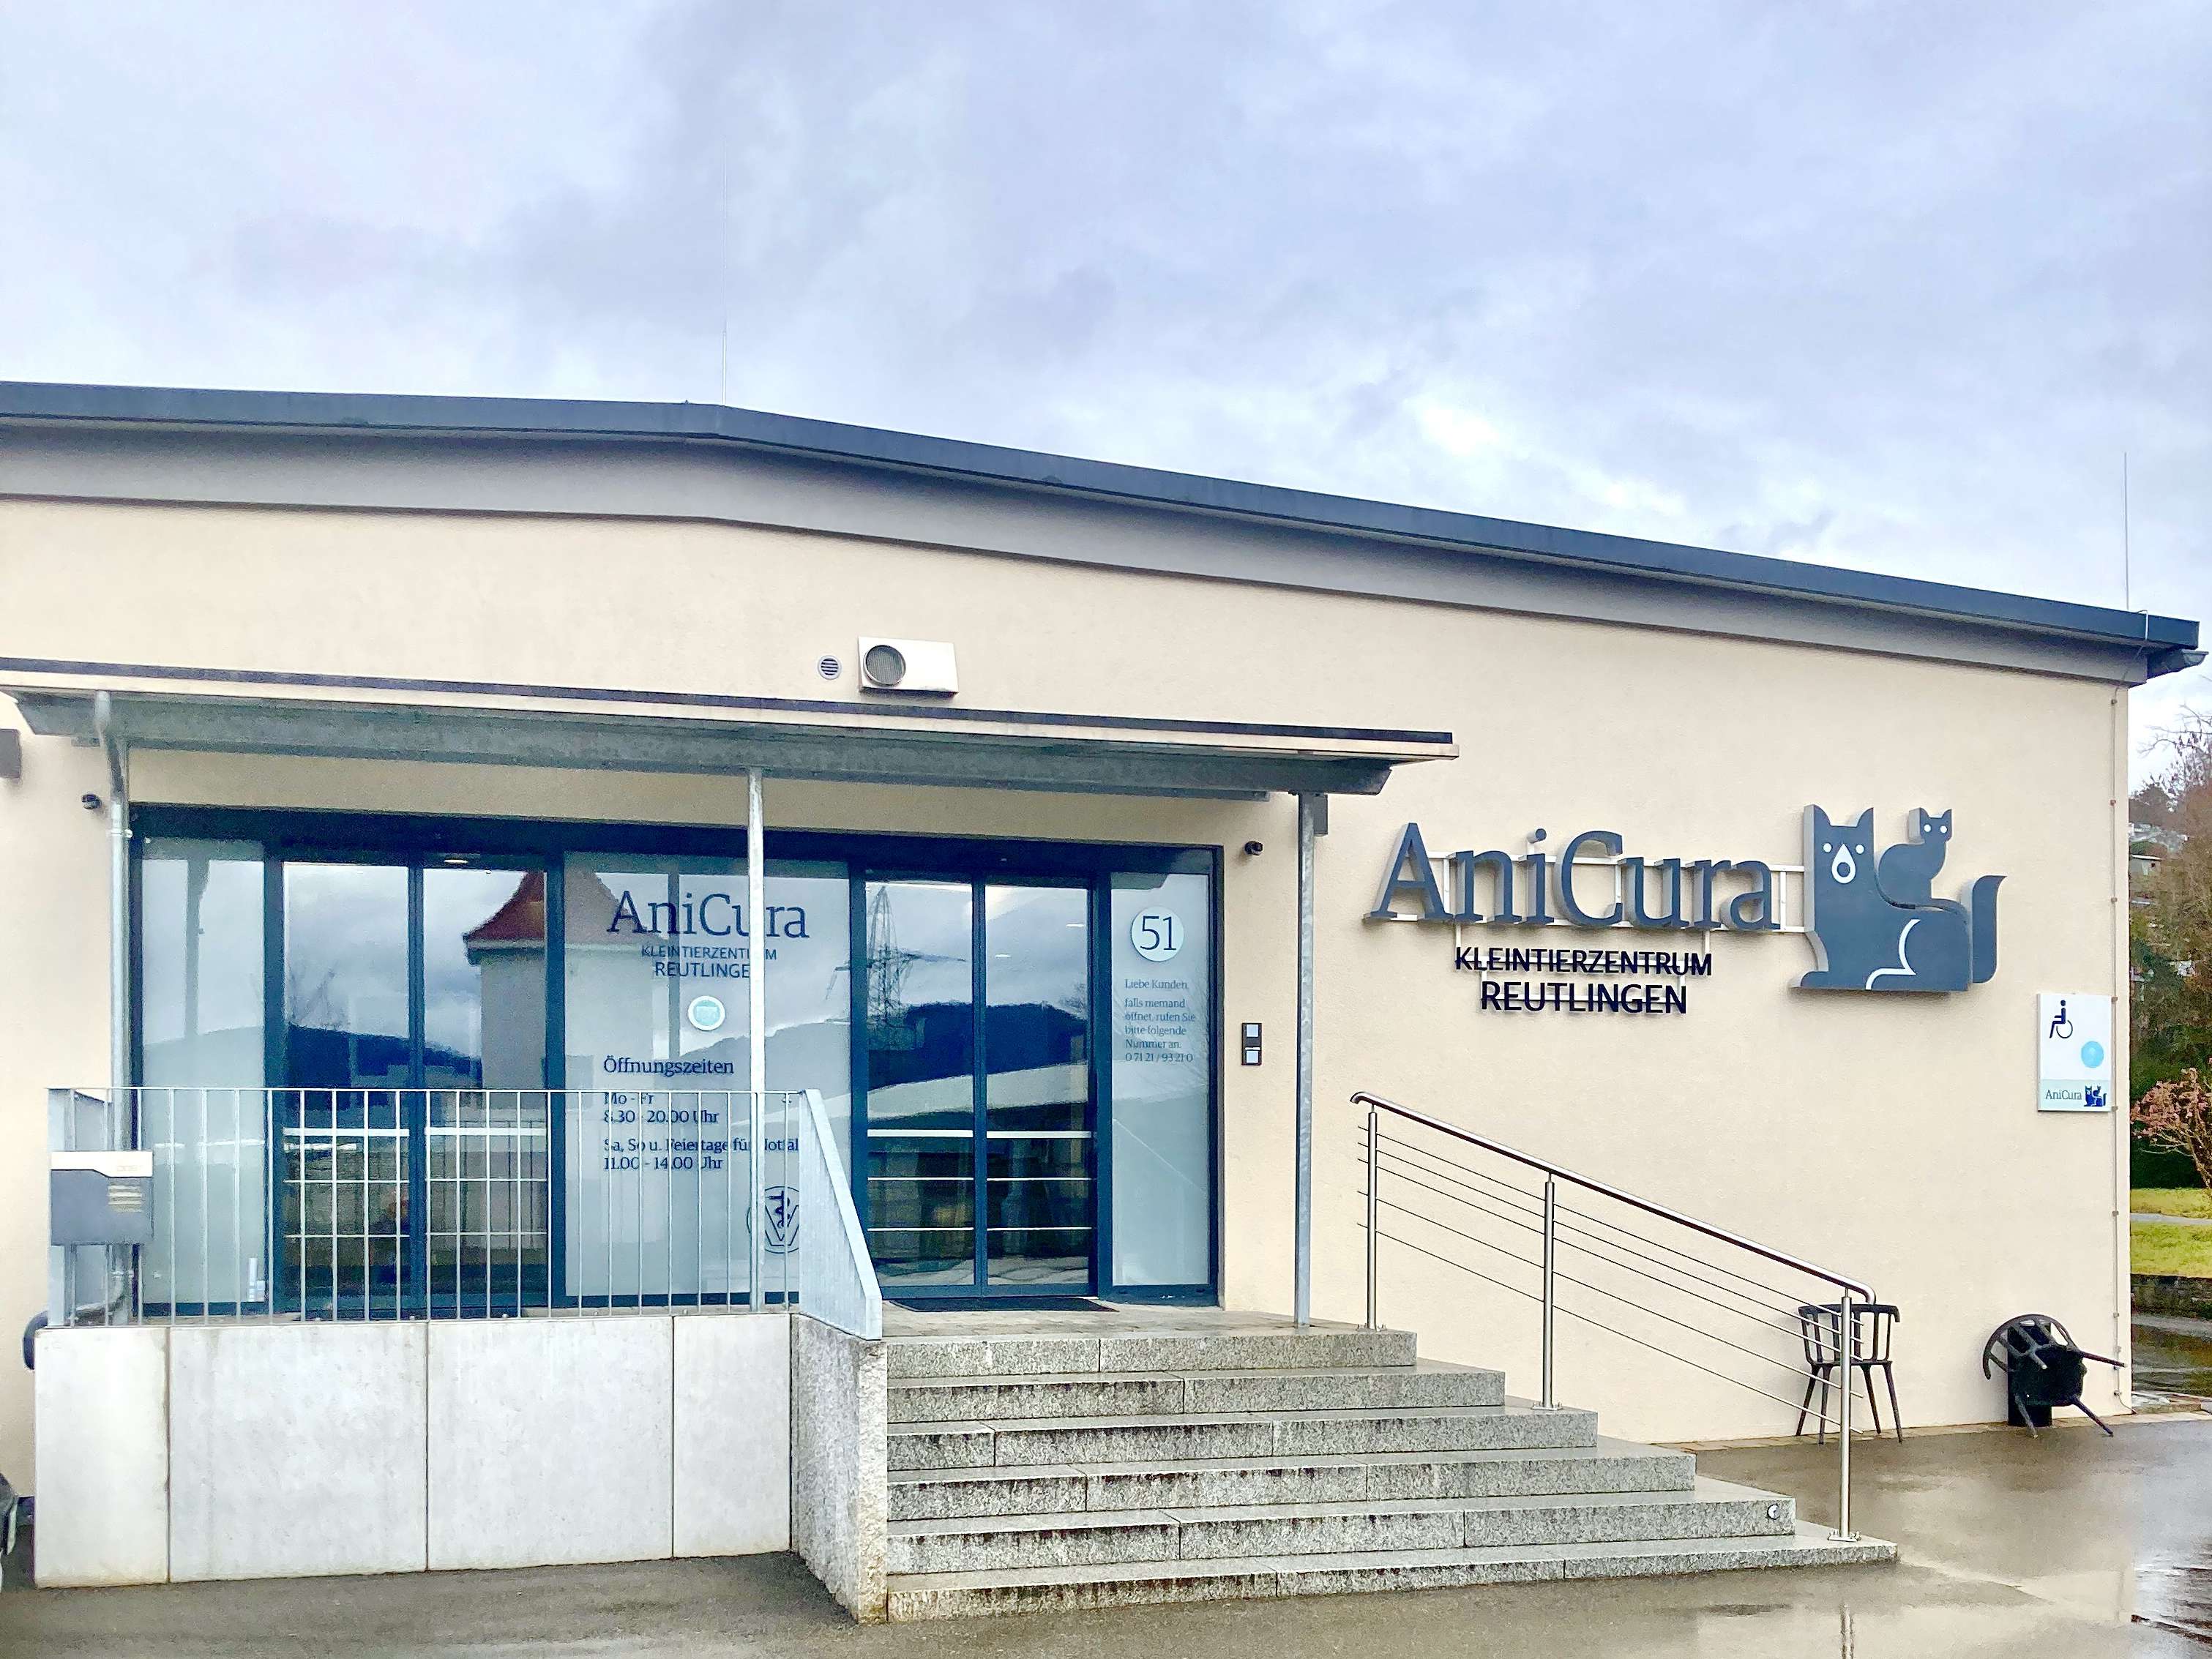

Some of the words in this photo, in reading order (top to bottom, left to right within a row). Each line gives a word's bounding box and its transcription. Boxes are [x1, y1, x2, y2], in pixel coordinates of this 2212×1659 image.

[1365, 823, 1780, 930] AniCura
[1140, 915, 1177, 951] 51
[641, 945, 777, 960] KLEINTIERZENTM
[1455, 946, 1712, 976] KLEINTIERZENTRUM
[655, 962, 750, 978] REUTLINGE
[1125, 978, 1149, 989] Liebe
[1124, 997, 1143, 1008] falls
[1145, 998, 1185, 1008] niemand
[1481, 981, 1686, 1014] REUTLINGEN
[1156, 1012, 1180, 1022] rufen
[1182, 1013, 1195, 1022] Sie
[1147, 1025, 1187, 1037] folgende
[1126, 1039, 1165, 1049] Nummer
[603, 1055, 734, 1077] Öffnungszeiten
[2045, 1090, 2082, 1100] AniCura
